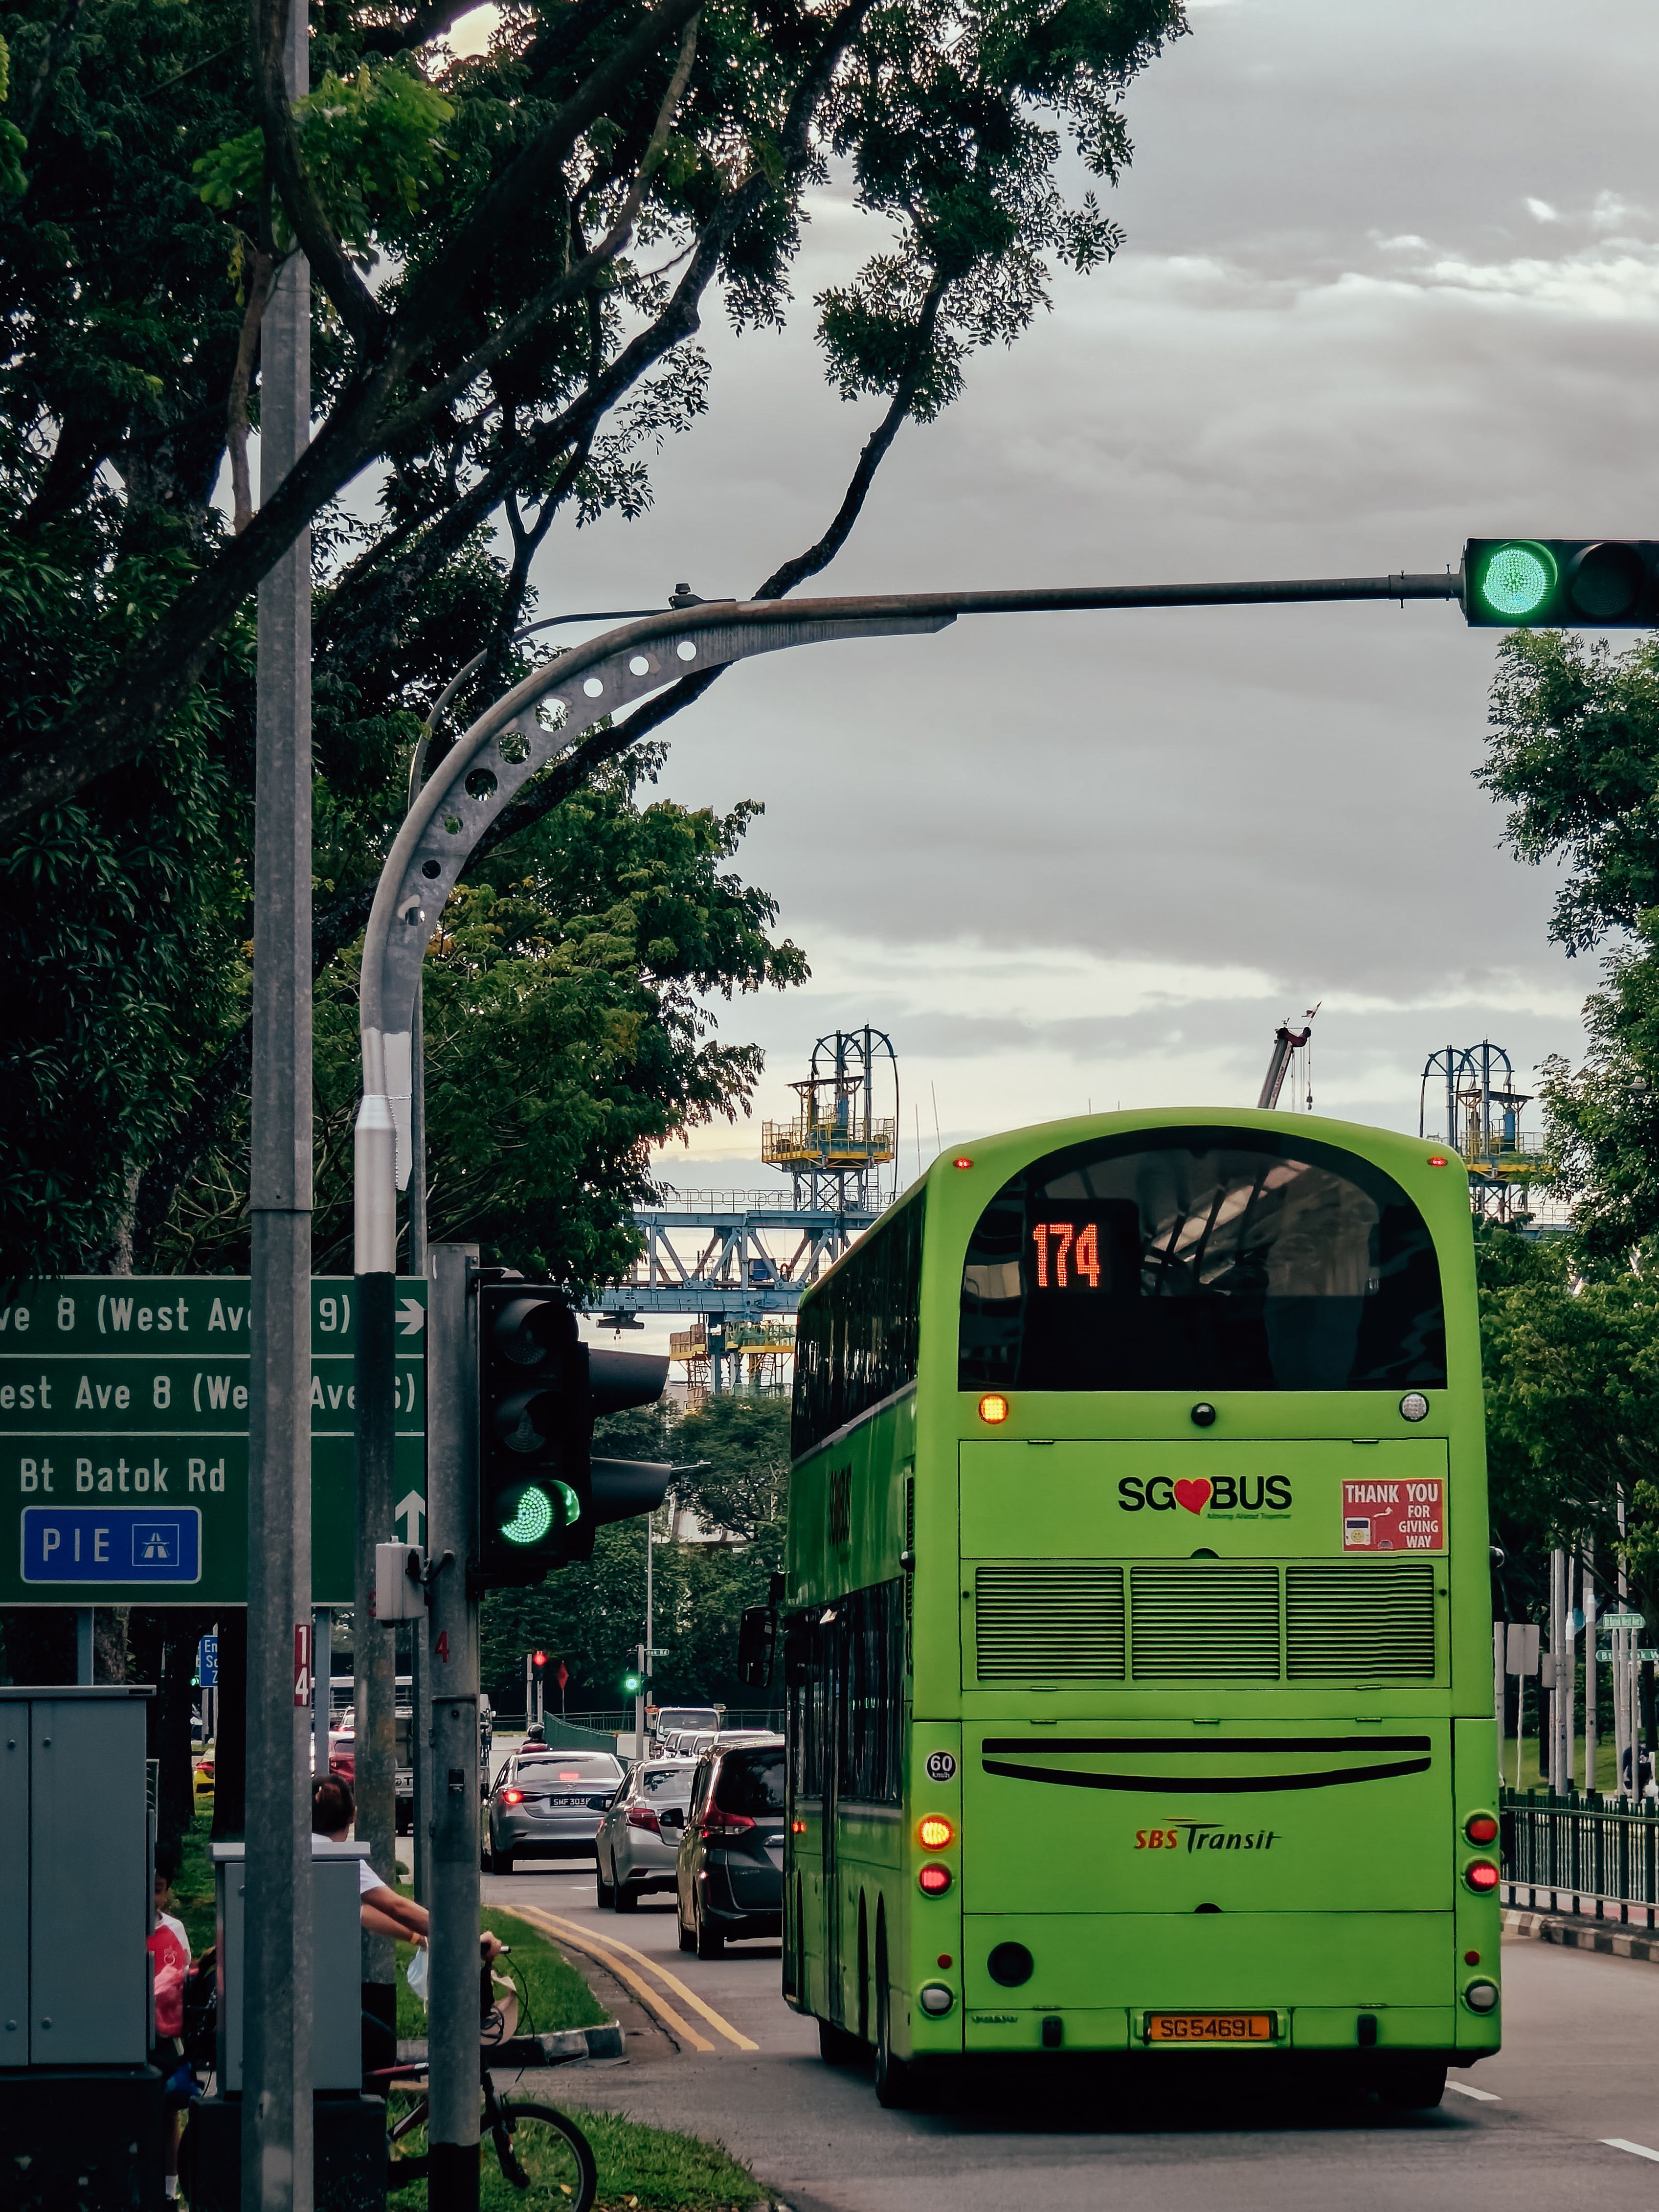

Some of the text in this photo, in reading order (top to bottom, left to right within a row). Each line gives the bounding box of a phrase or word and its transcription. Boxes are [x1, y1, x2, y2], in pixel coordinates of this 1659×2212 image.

[1032, 1223, 1100, 1287] 174
[57, 1297, 75, 1331] 8
[98, 1295, 189, 1333] (West
[208, 1298, 251, 1331] Av
[319, 1295, 350, 1333] 9)
[75, 1376, 130, 1409] Ave
[153, 1376, 171, 1409] 8
[21, 1458, 225, 1492] Bt Batok Rd
[1345, 1483, 1438, 1503] THANK YOU
[1408, 1505, 1430, 1517] FOR
[1398, 1520, 1438, 1533] GIVING
[1406, 1535, 1432, 1548] WAY
[43, 1528, 110, 1561] PIE
[435, 1630, 449, 1663] 4
[931, 1755, 953, 1771] 60
[1134, 1824, 1283, 1854] SBS Transit
[1160, 2019, 1262, 2038] SG5469L
